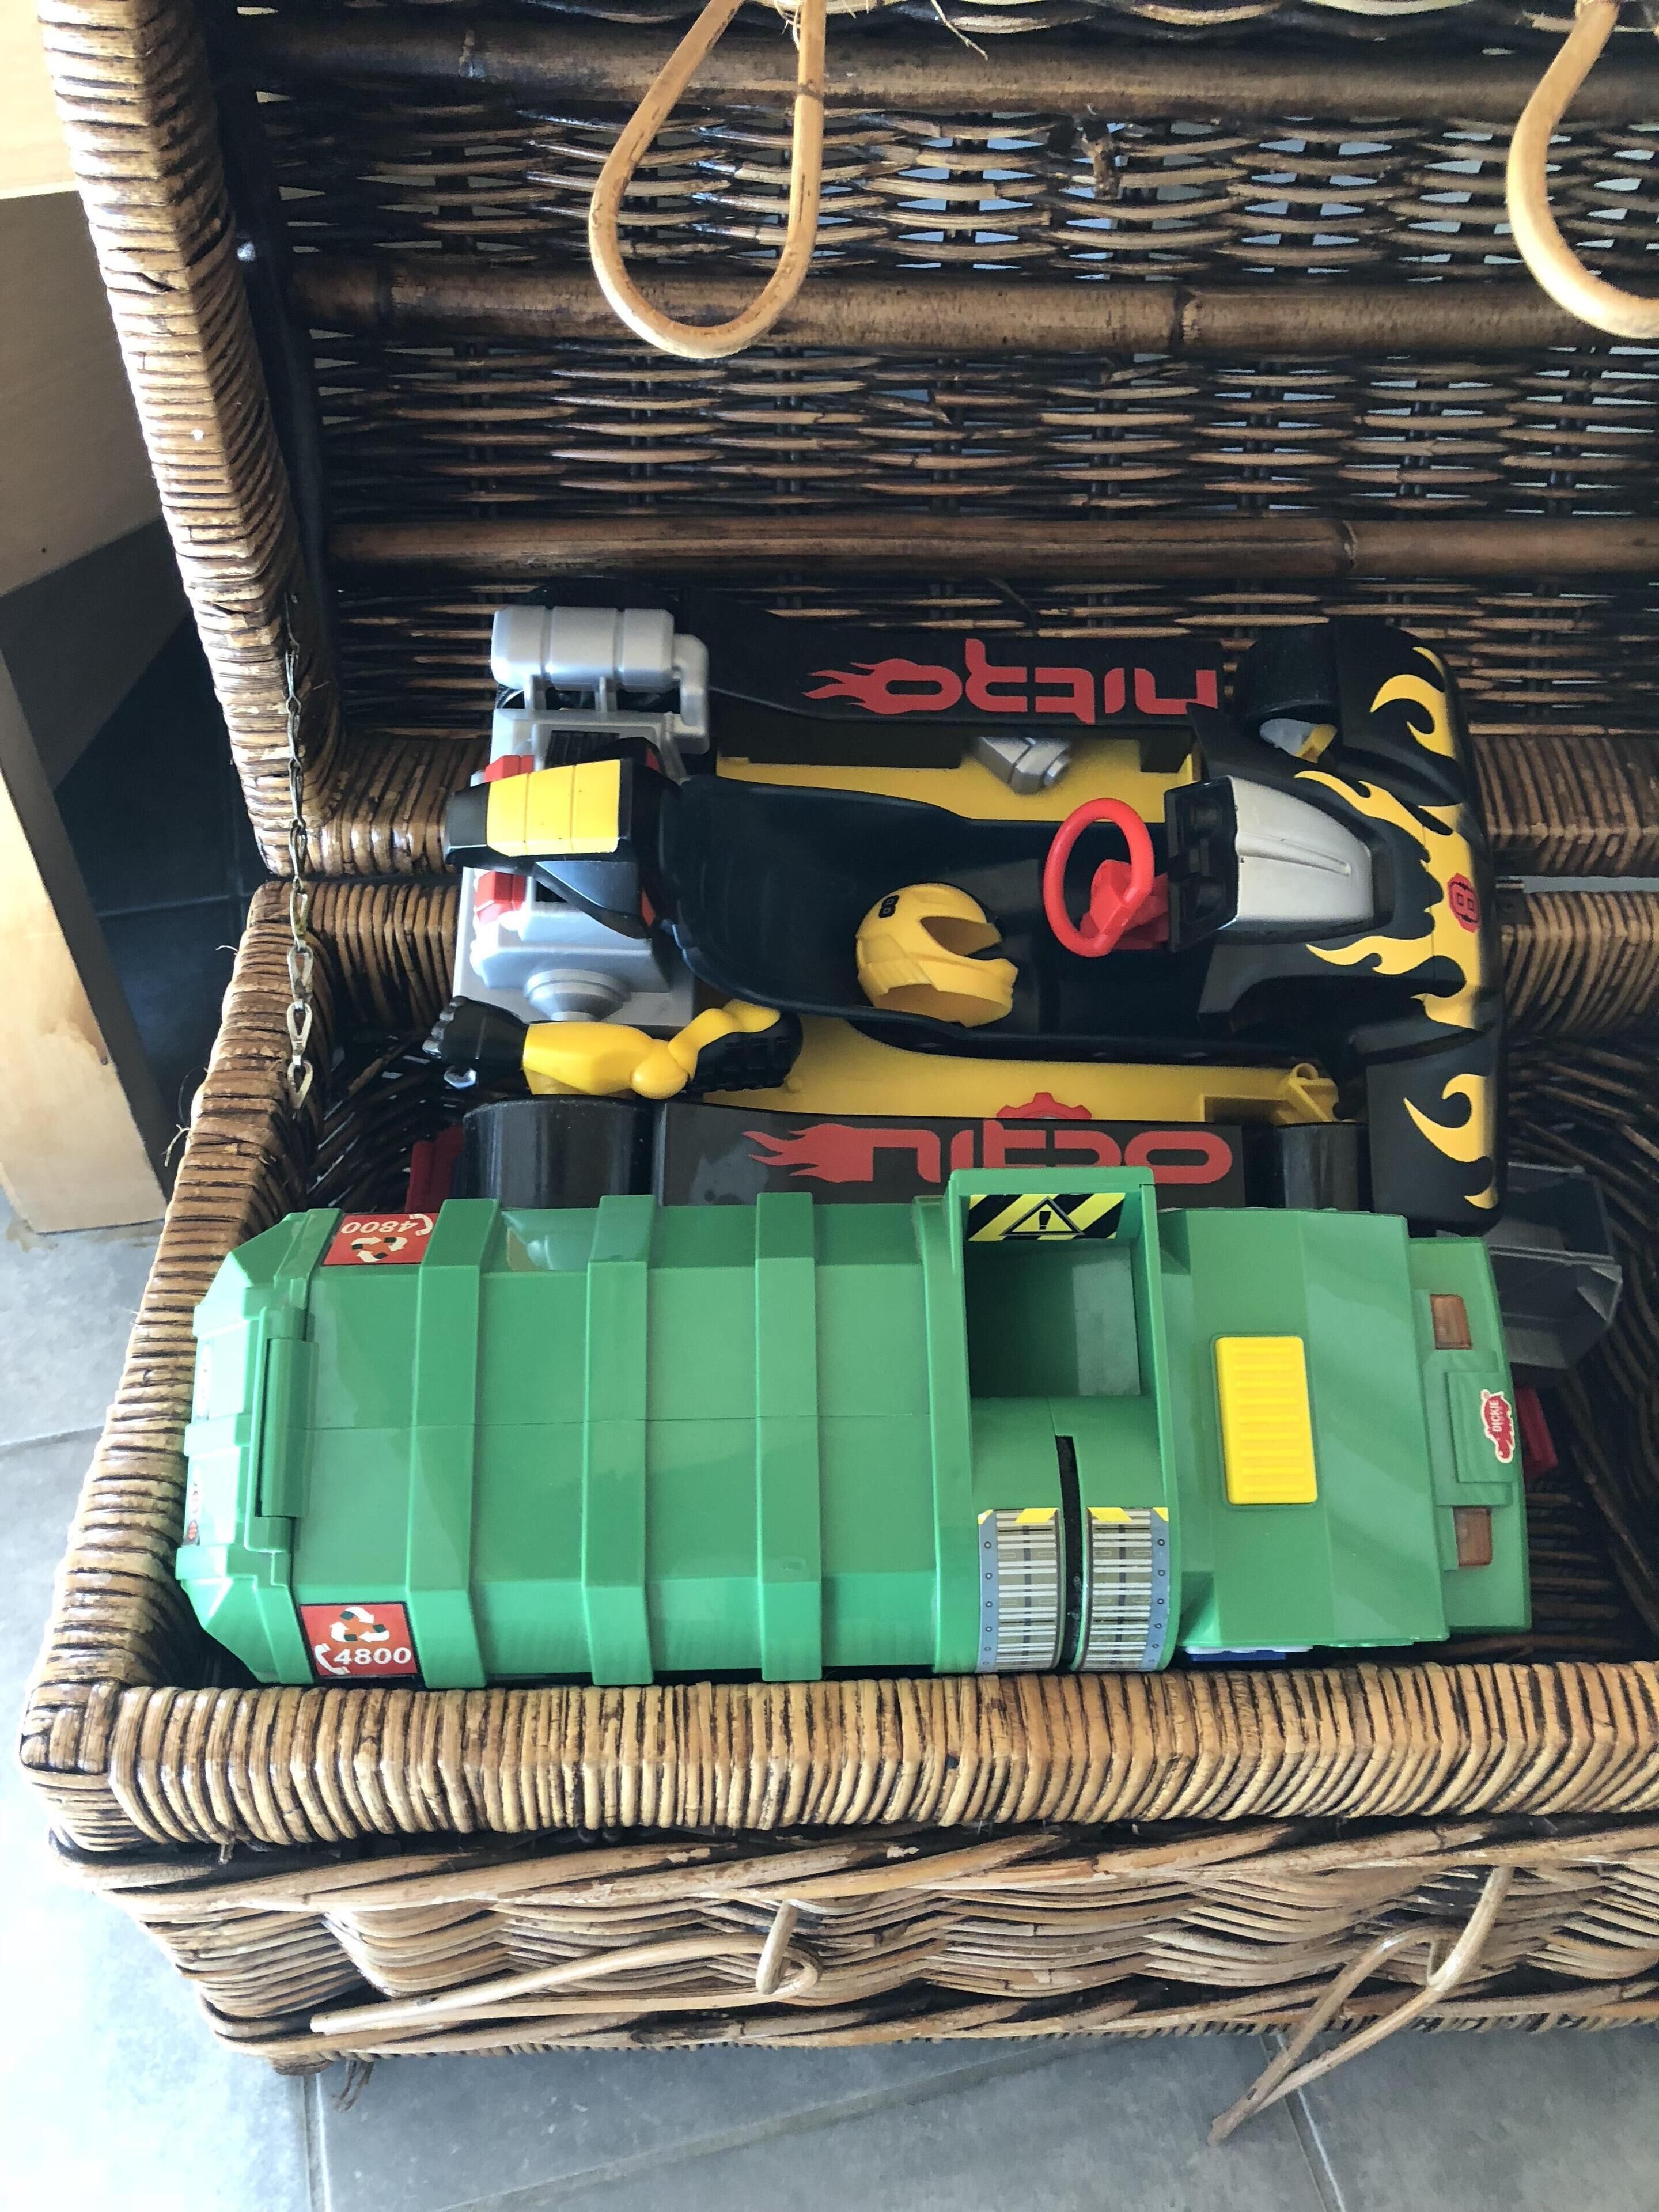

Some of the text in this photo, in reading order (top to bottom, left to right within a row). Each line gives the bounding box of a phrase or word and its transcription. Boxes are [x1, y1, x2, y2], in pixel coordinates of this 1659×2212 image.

[341, 1220, 419, 1234] 4800
[1488, 1400, 1503, 1433] DICKIE
[333, 1647, 412, 1665] 4800
